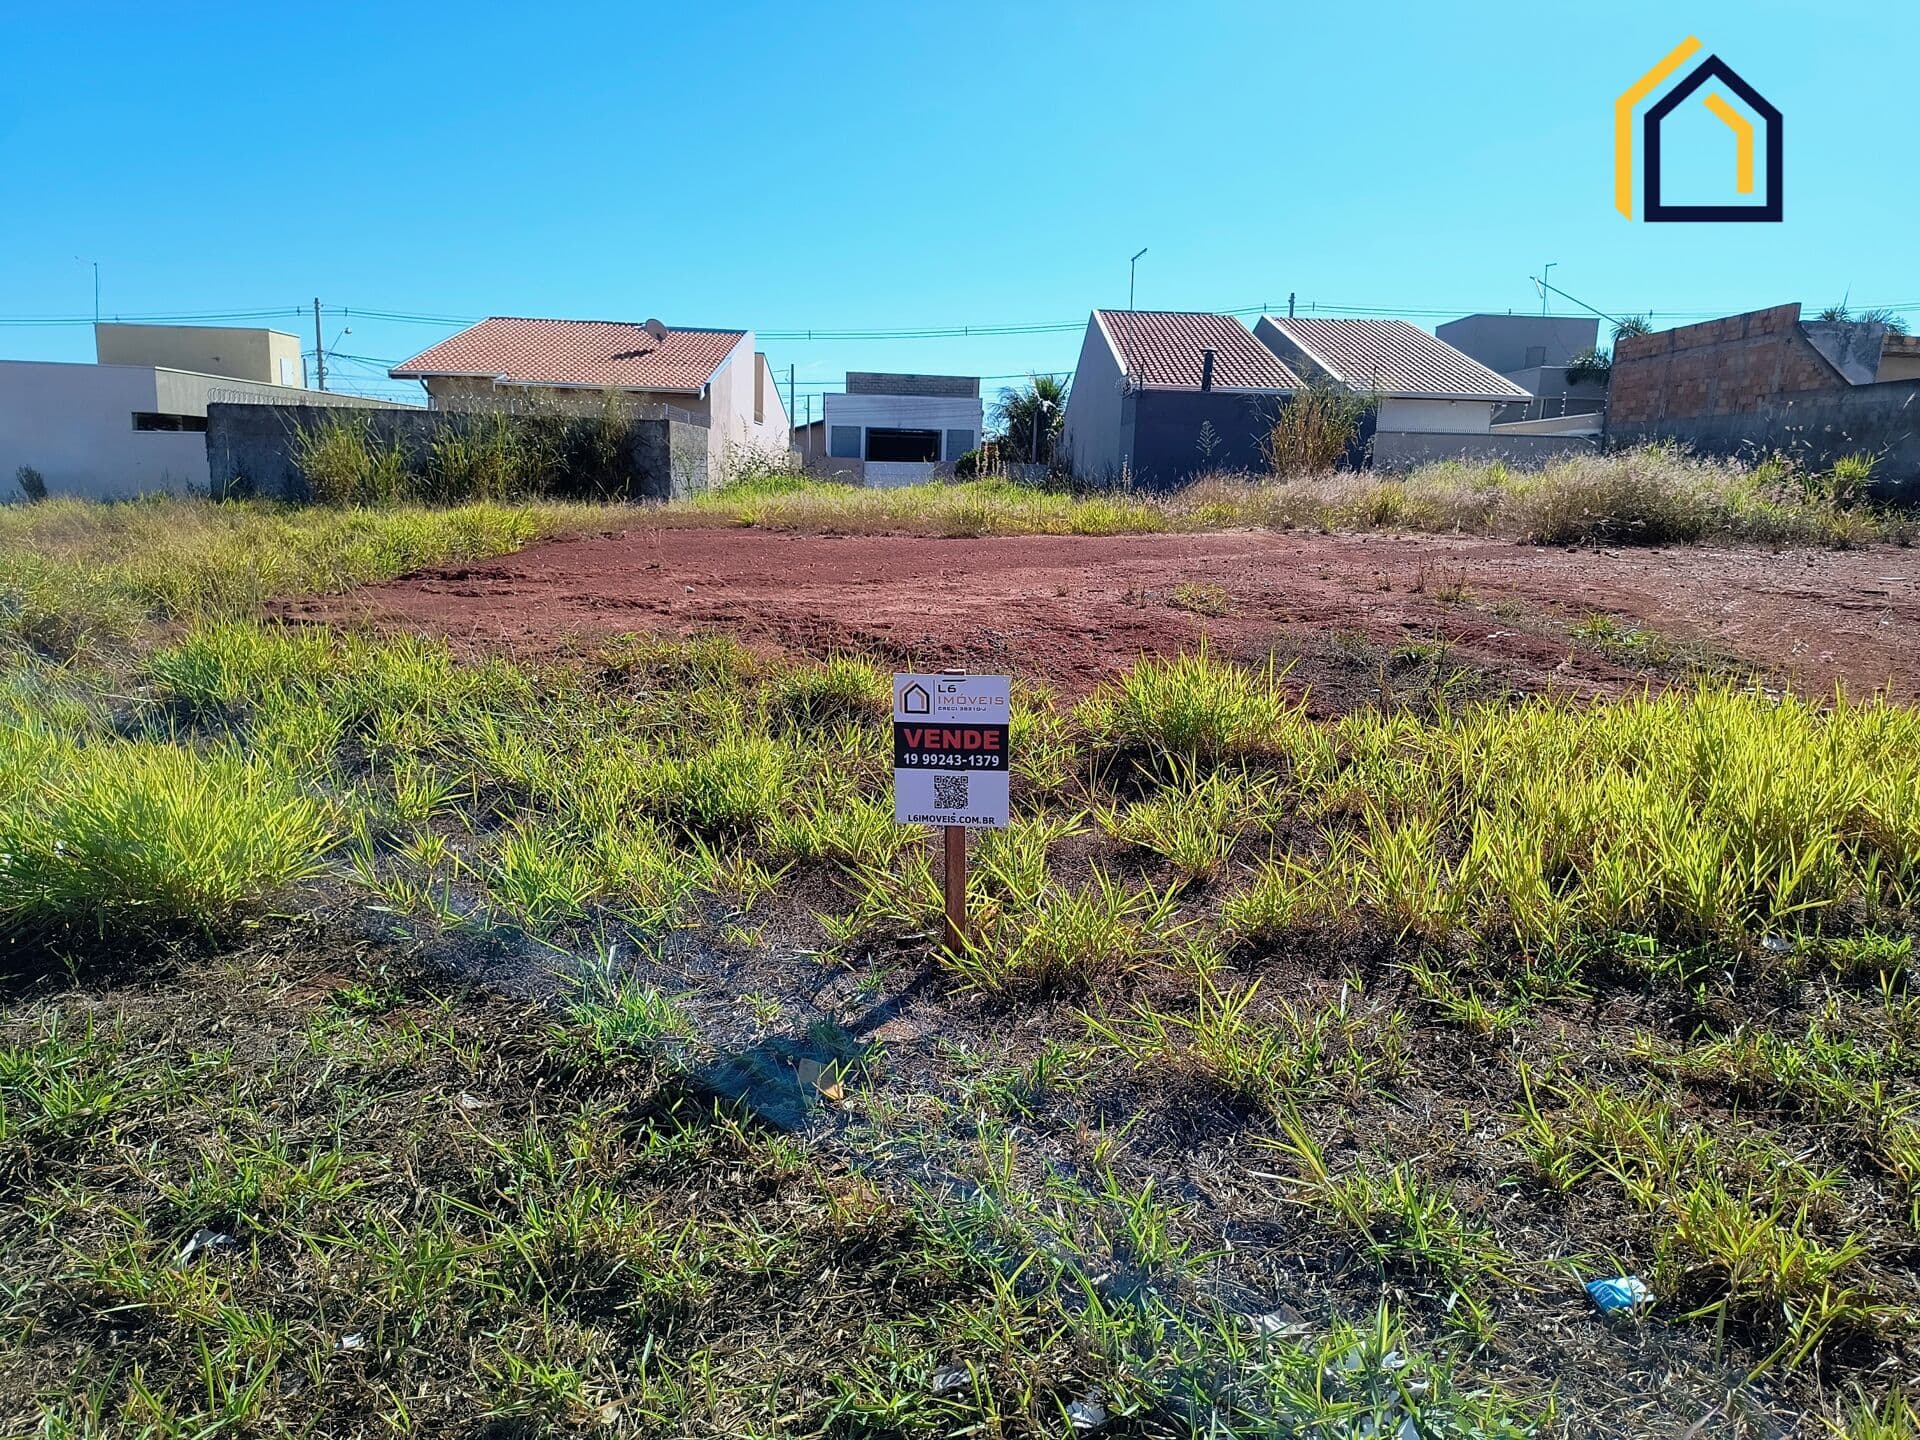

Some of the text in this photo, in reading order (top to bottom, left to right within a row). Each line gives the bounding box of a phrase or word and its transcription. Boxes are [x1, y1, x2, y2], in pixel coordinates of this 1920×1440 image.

[937, 684, 957, 693] L6
[938, 692, 1004, 705] IMÓVEIS
[903, 728, 1000, 750] VENDE
[903, 753, 1000, 767] 19 99243-1379
[907, 814, 996, 825] L6IMOVEIS.COM.BR
